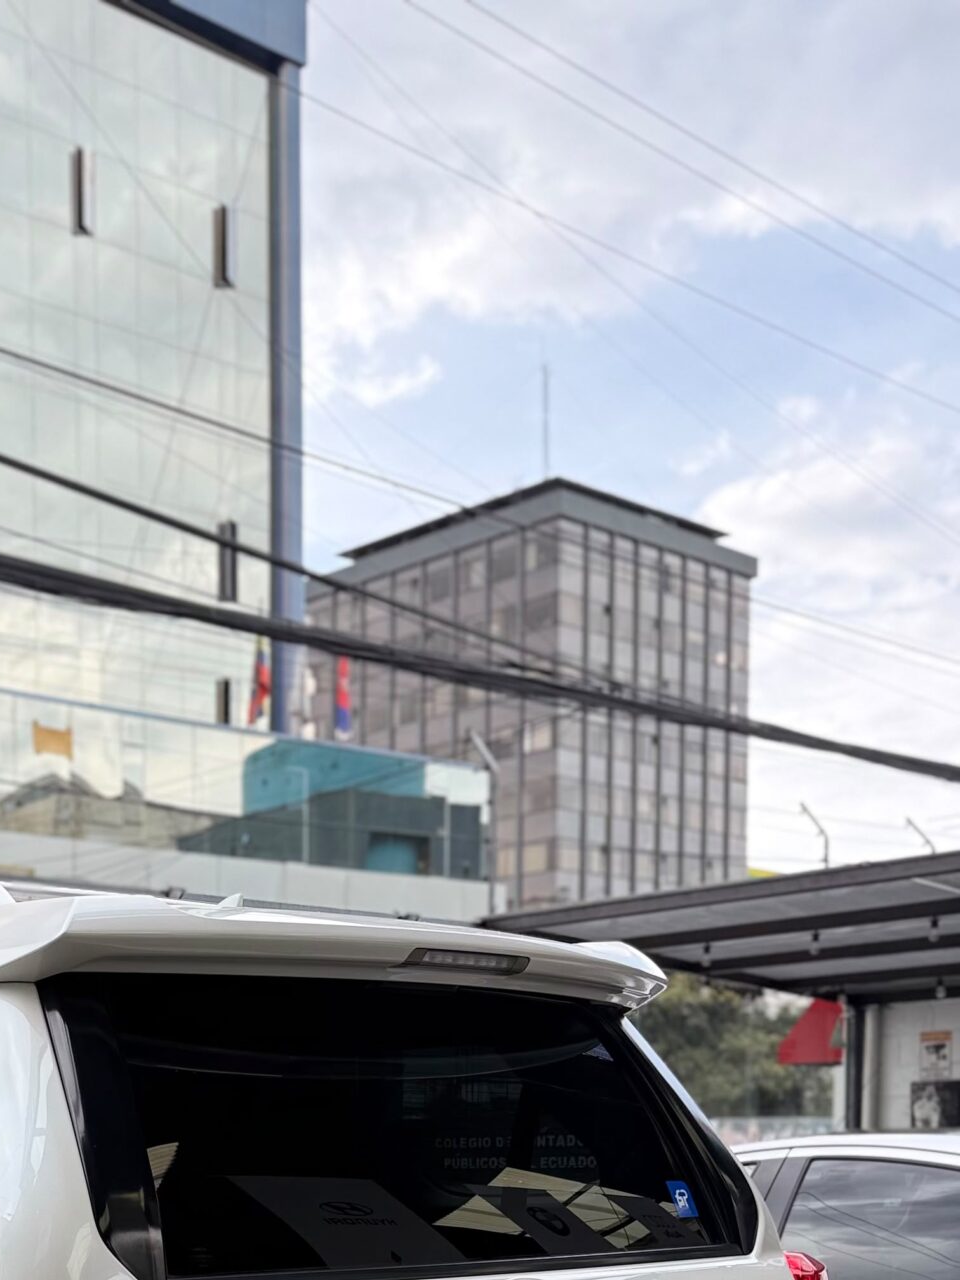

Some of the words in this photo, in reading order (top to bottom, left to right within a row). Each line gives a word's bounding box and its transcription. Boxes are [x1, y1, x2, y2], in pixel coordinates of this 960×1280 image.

[435, 1136, 491, 1149] COLEGIO
[444, 1152, 507, 1169] PÚBLICOS
[540, 1156, 597, 1169] ECUADO
